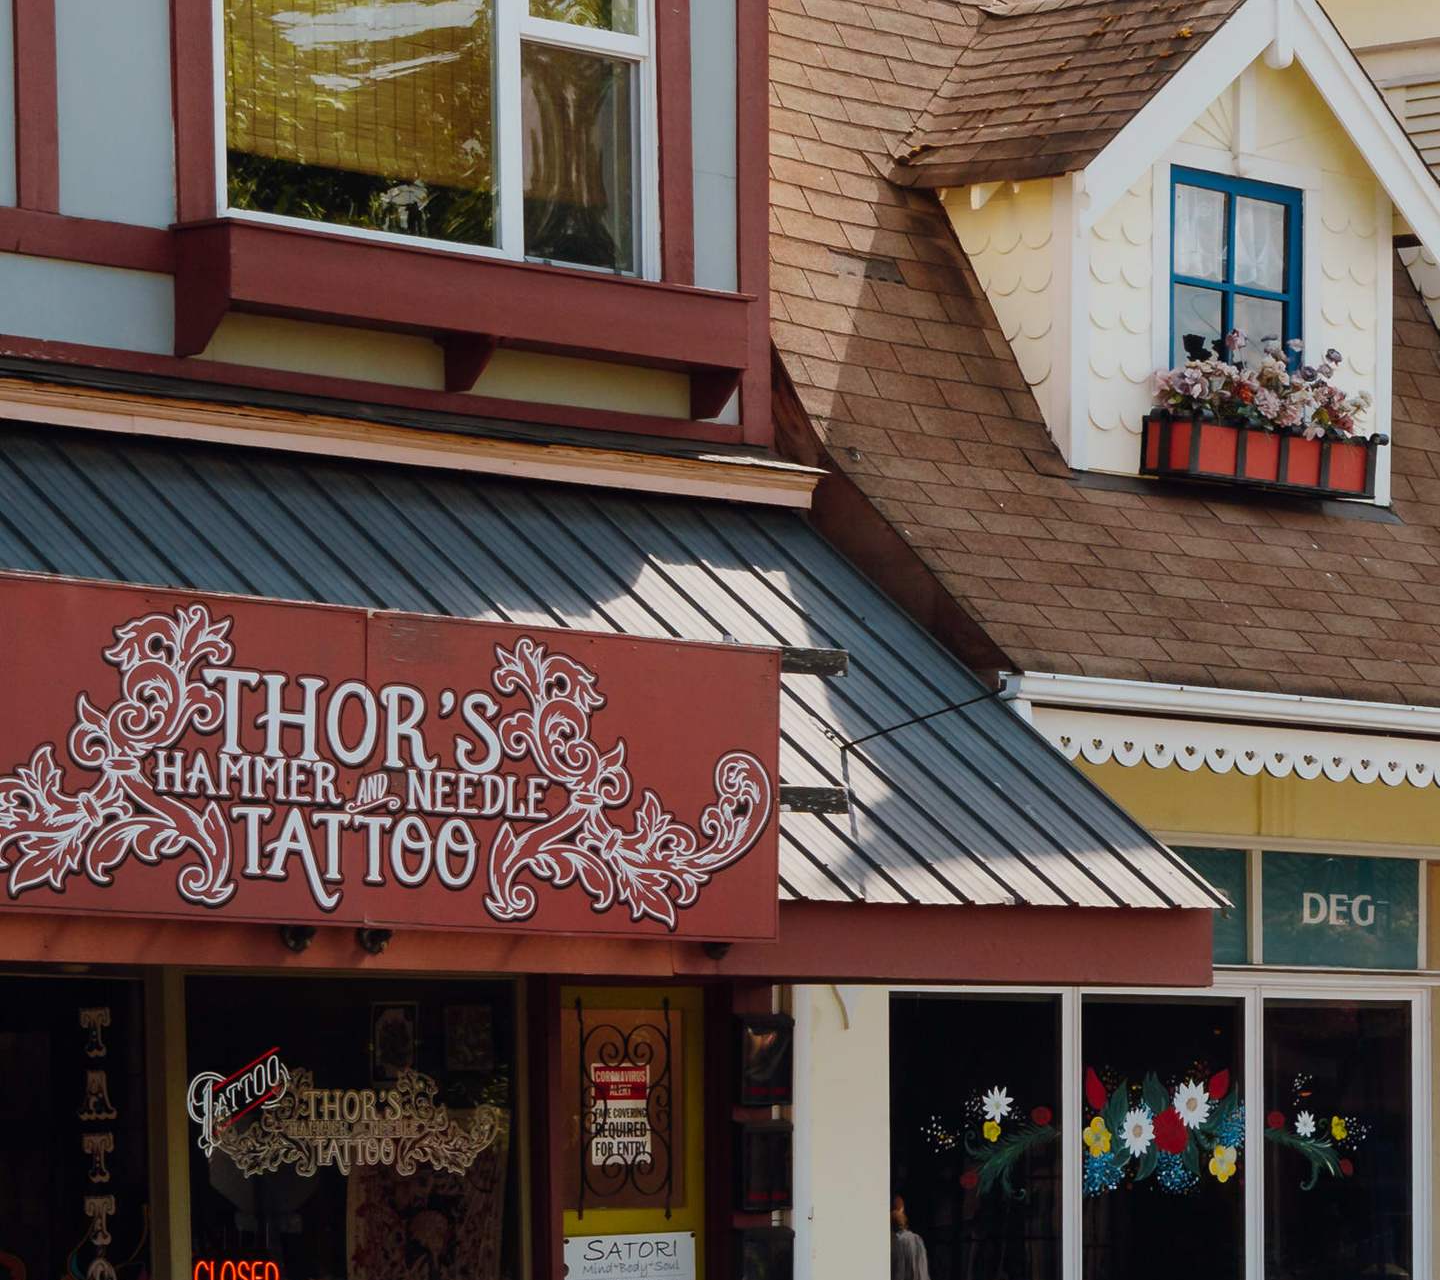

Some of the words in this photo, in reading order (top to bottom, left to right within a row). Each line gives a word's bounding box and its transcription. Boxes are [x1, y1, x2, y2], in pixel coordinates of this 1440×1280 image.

[202, 668, 501, 774] THOR'S
[154, 750, 343, 804] HAMMER
[354, 773, 390, 803] AND
[405, 768, 552, 819] NEEDLE
[231, 806, 478, 909] TATTOO
[187, 1054, 290, 1159] TATTOO
[301, 1090, 403, 1122] THOR'S
[595, 1122, 647, 1138] REQUIRED
[596, 1142, 613, 1156] FOR
[617, 1141, 647, 1155] ENTRY
[312, 1138, 396, 1176] TATTOO
[583, 1239, 677, 1260] SATORI
